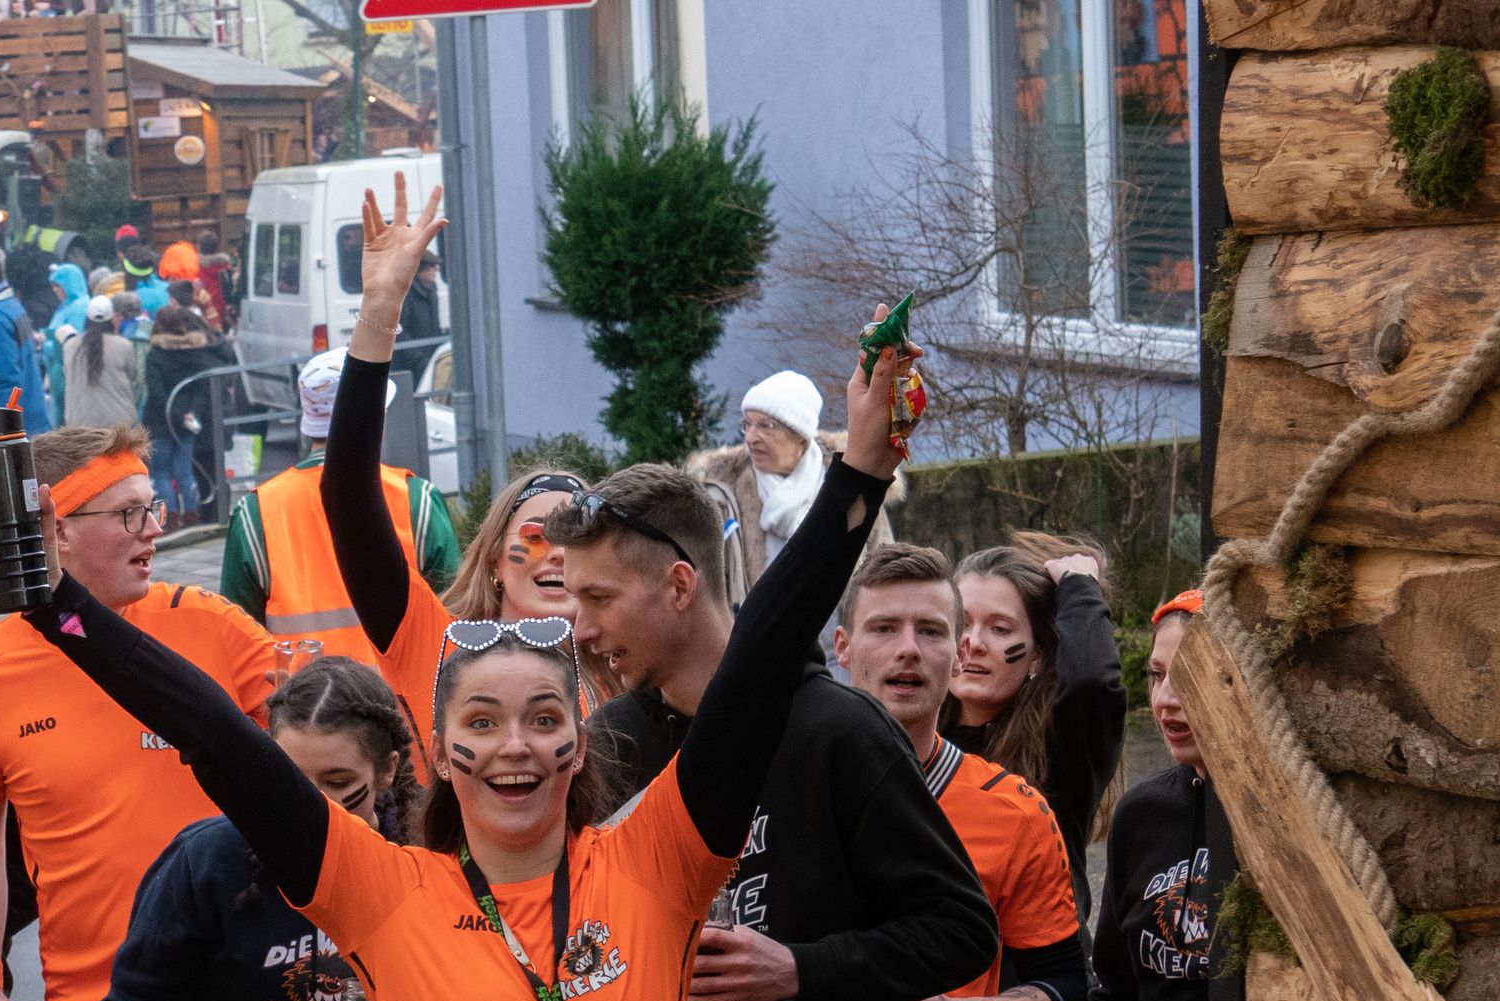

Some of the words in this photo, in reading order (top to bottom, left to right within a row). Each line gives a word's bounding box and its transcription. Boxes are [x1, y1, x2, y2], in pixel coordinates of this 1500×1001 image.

[19, 717, 56, 738] JAKO
[559, 946, 628, 1001] KERLE
[1140, 929, 1210, 980] KER
